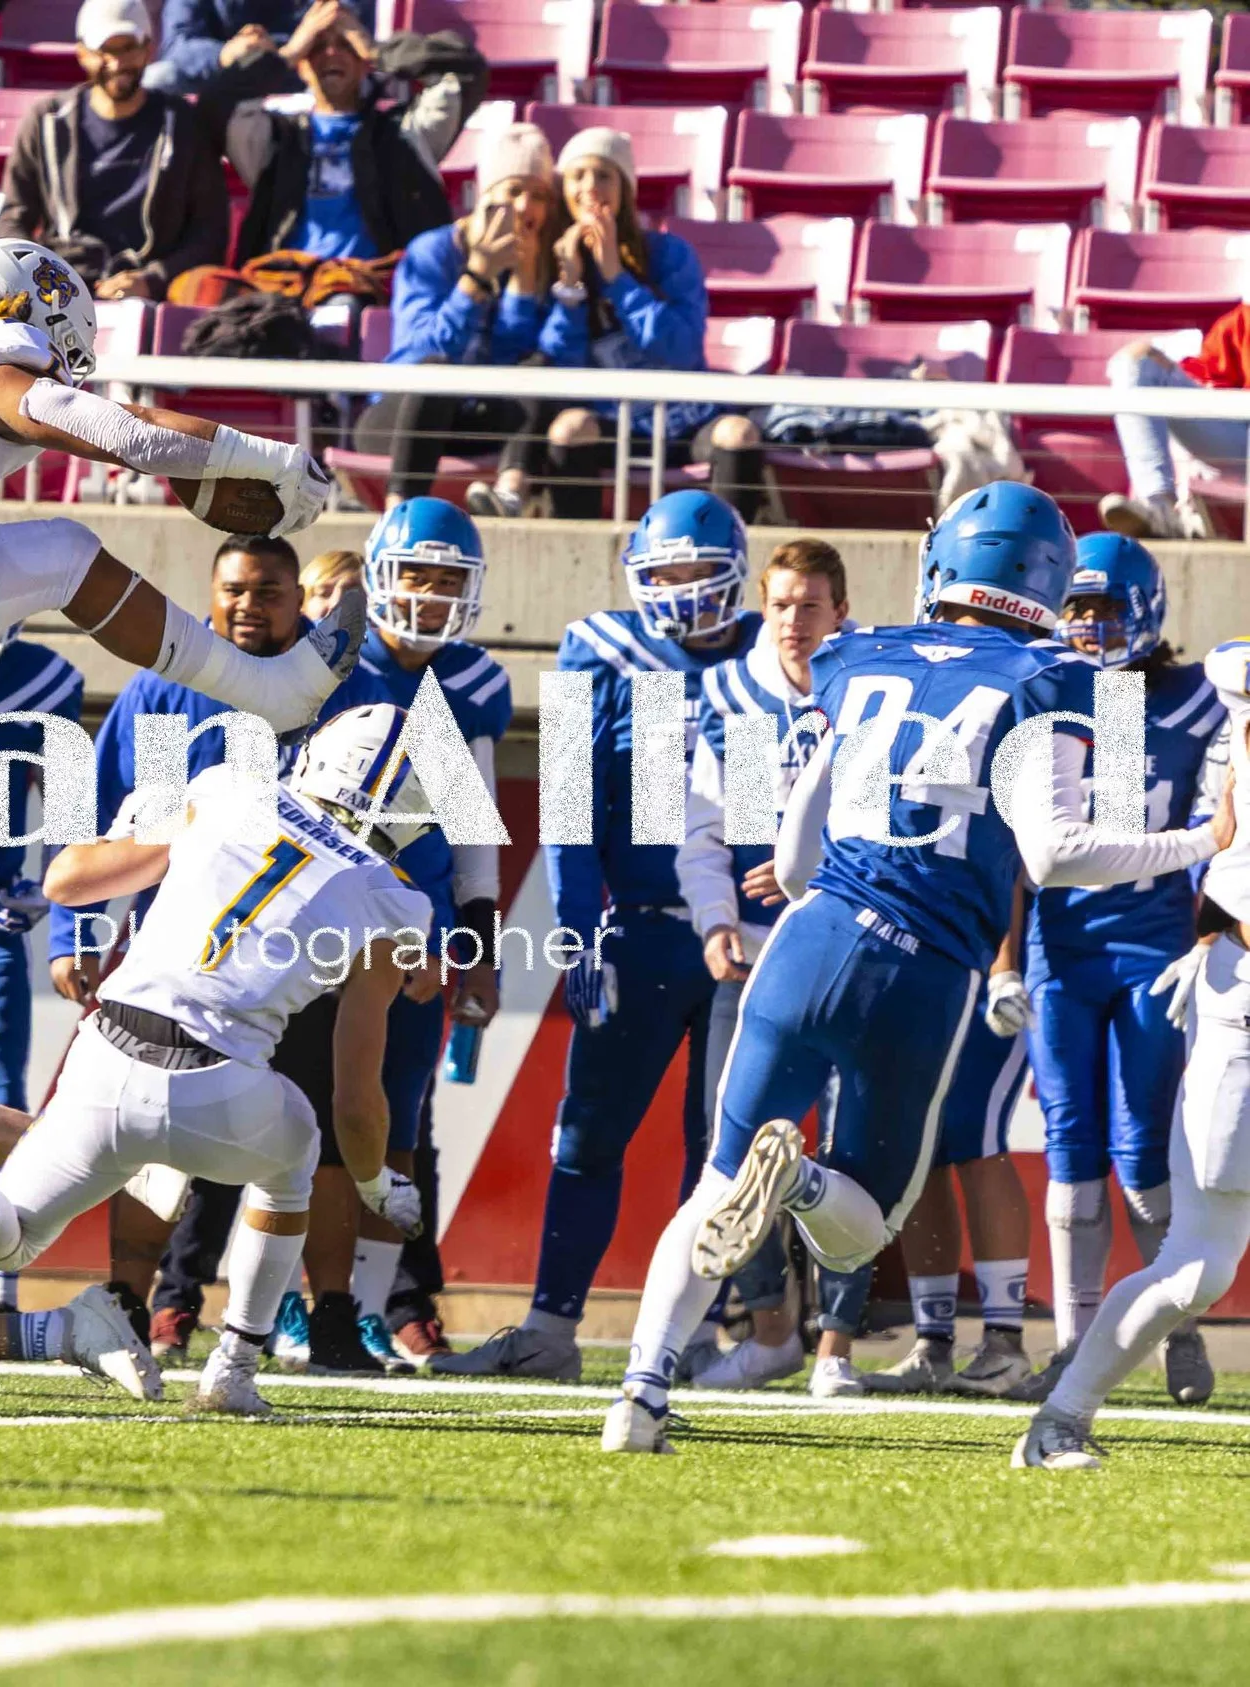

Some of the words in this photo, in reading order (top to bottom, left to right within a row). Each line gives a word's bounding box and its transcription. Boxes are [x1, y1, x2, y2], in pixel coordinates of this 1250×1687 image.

[969, 588, 1045, 623] Riddell
[276, 797, 370, 866] EDERSEN
[200, 834, 315, 972] 1
